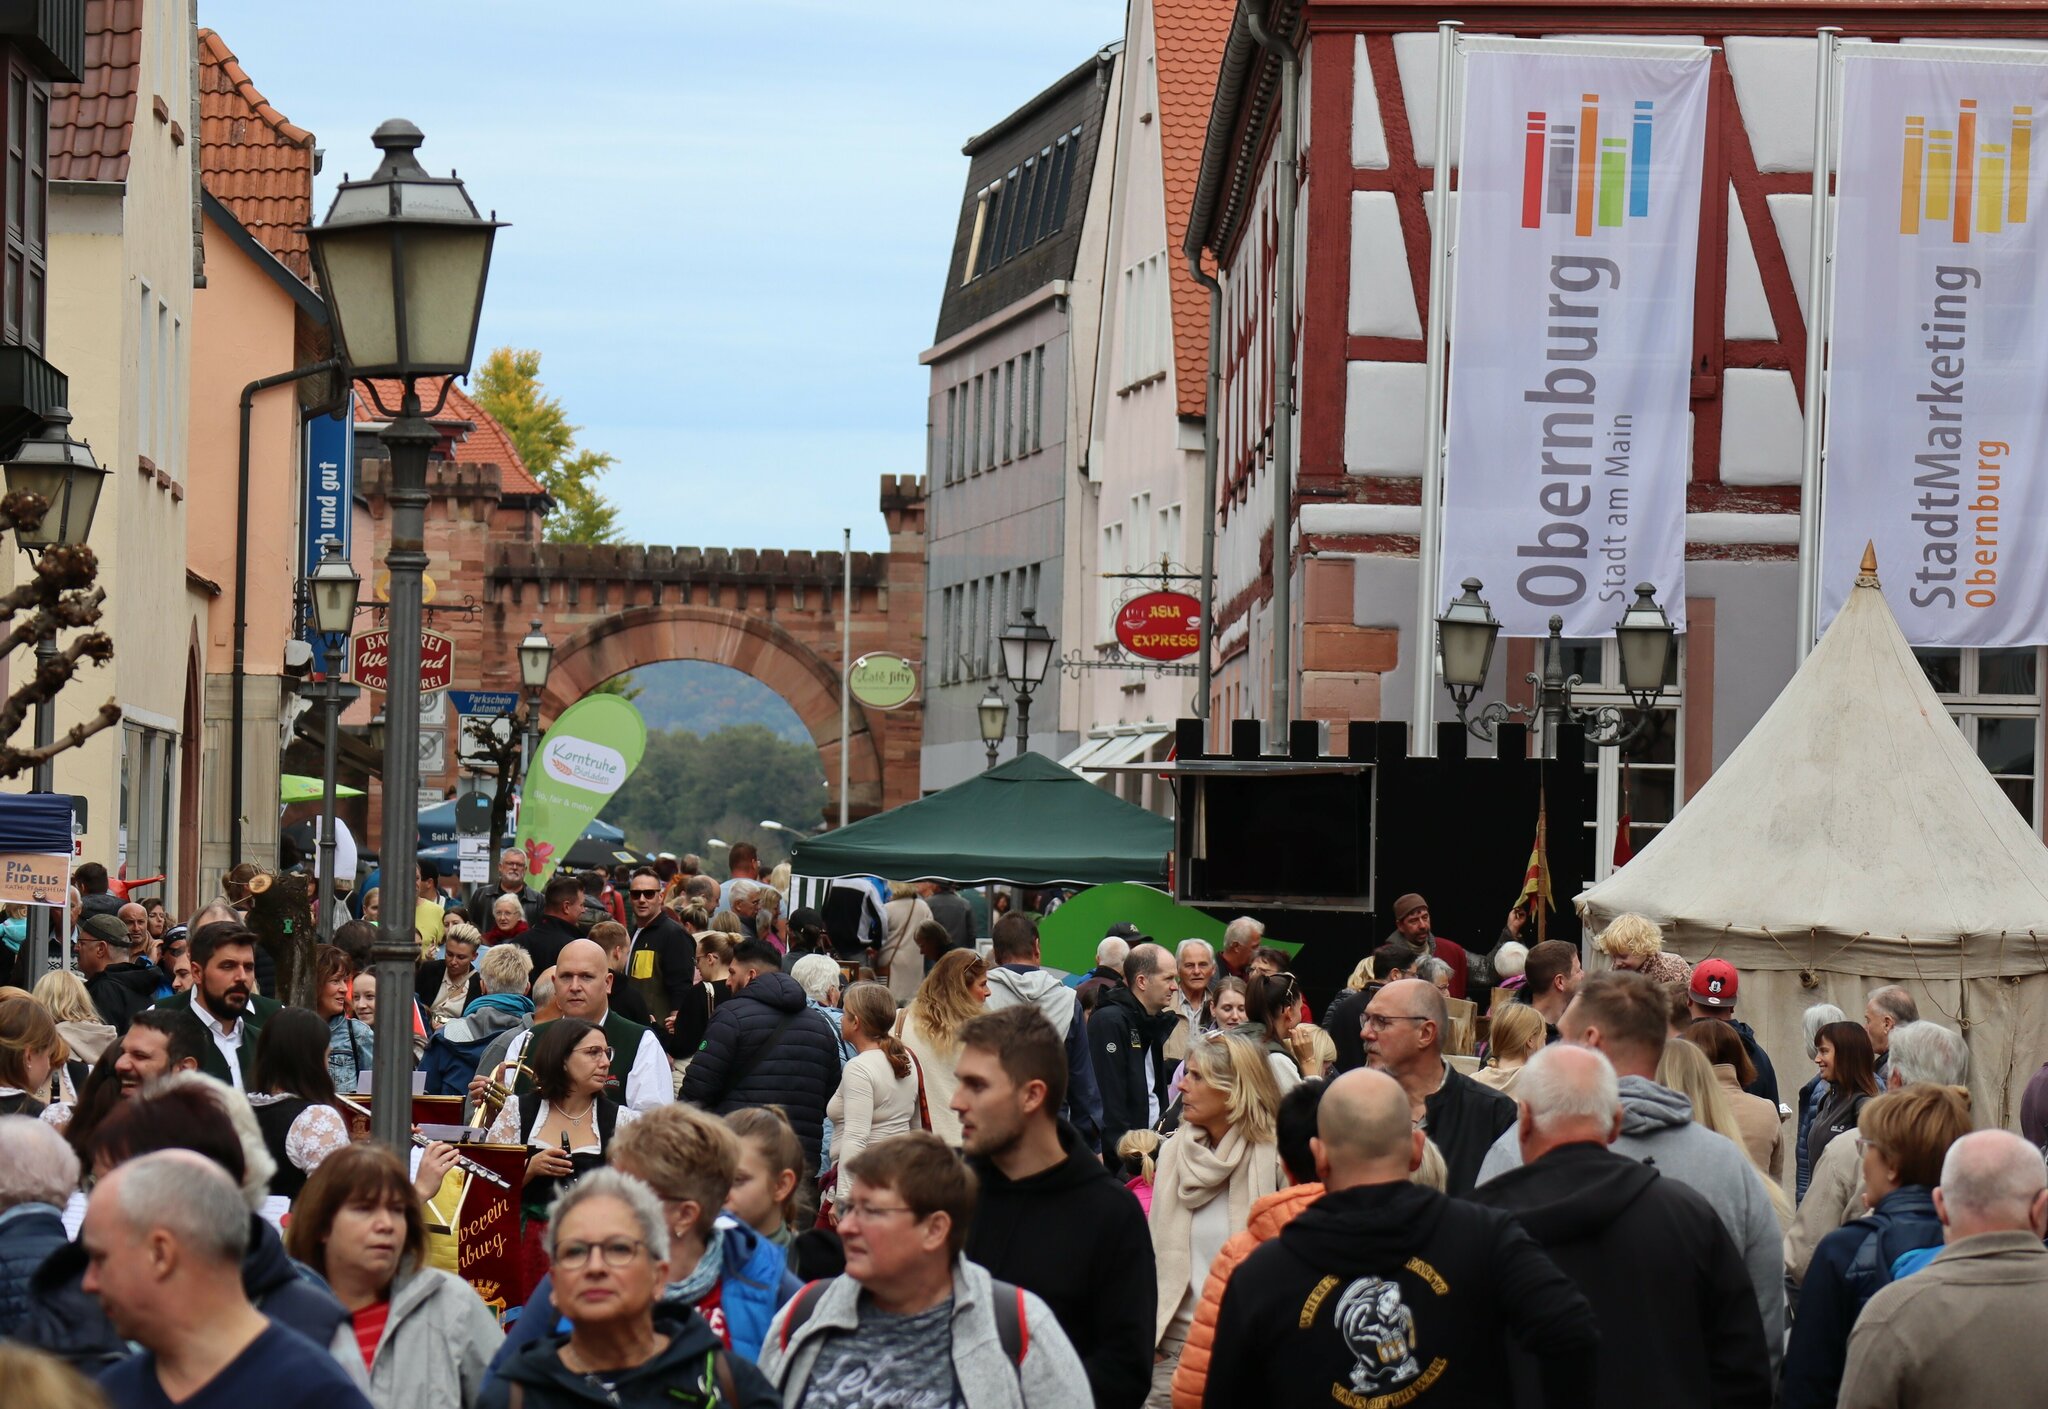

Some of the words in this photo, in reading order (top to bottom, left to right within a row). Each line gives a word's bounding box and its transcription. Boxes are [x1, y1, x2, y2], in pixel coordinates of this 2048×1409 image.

[1517, 255, 1621, 607] Obernburg
[1910, 265, 1982, 609] StadtMarketing
[1604, 413, 1633, 477] Main
[319, 462, 340, 491] gut
[316, 495, 337, 529] und
[1605, 487, 1628, 526] am
[1965, 440, 2010, 608] Obernburg
[1598, 531, 1629, 603] Stadt
[1148, 605, 1181, 618] ASIA
[365, 633, 442, 653] BÄREI
[1132, 633, 1198, 647] EXPRESS
[358, 651, 448, 669] Wend
[364, 673, 442, 689] KONREI
[468, 693, 512, 704] Parkschein
[552, 743, 617, 774] Korntruhe
[431, 832, 448, 841] Seit
[6, 872, 59, 885] FIDELIS
[7, 861, 32, 873] PIA
